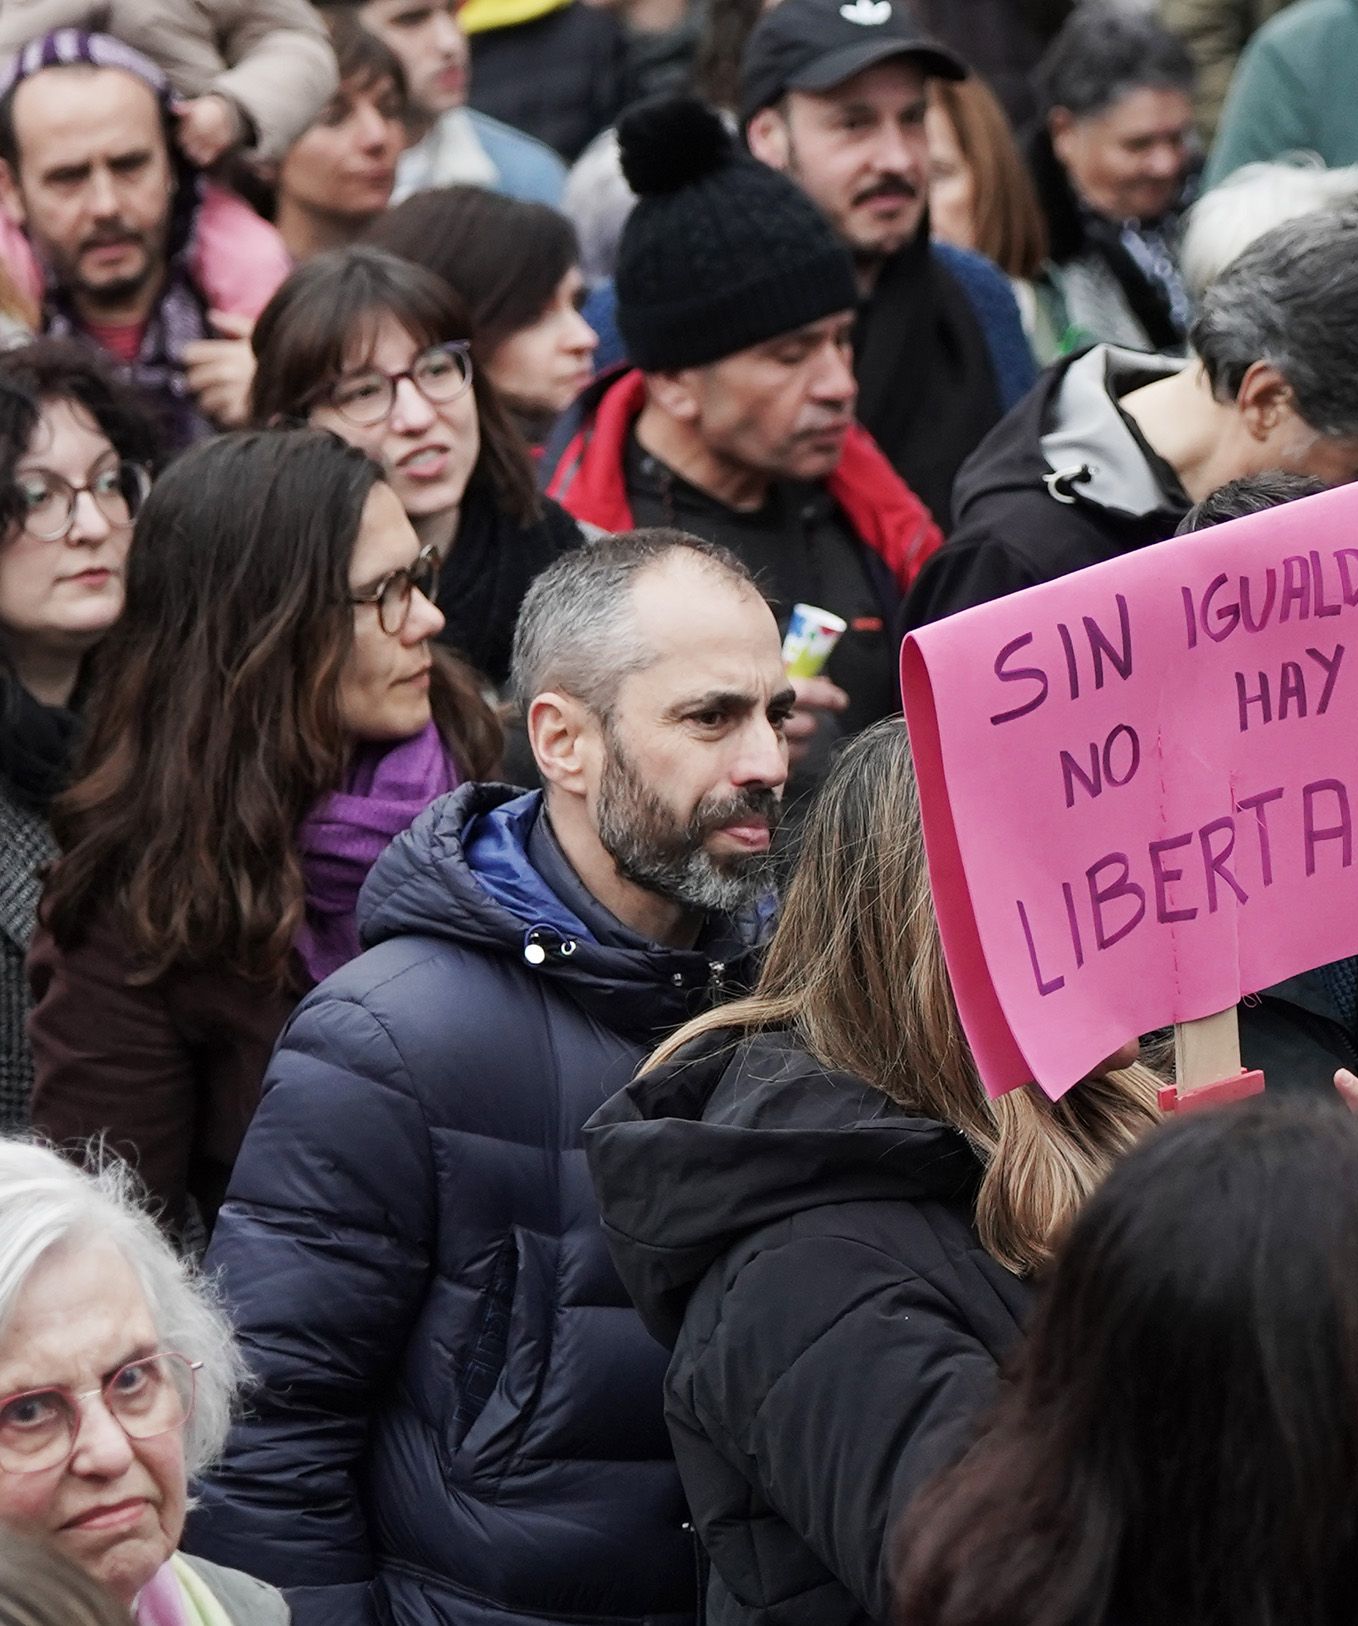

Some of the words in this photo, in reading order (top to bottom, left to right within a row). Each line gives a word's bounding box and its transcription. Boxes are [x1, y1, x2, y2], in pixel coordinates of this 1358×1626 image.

[990, 594, 1132, 725] SIN
[1060, 723, 1140, 808] NO
[1234, 644, 1344, 732] HAY
